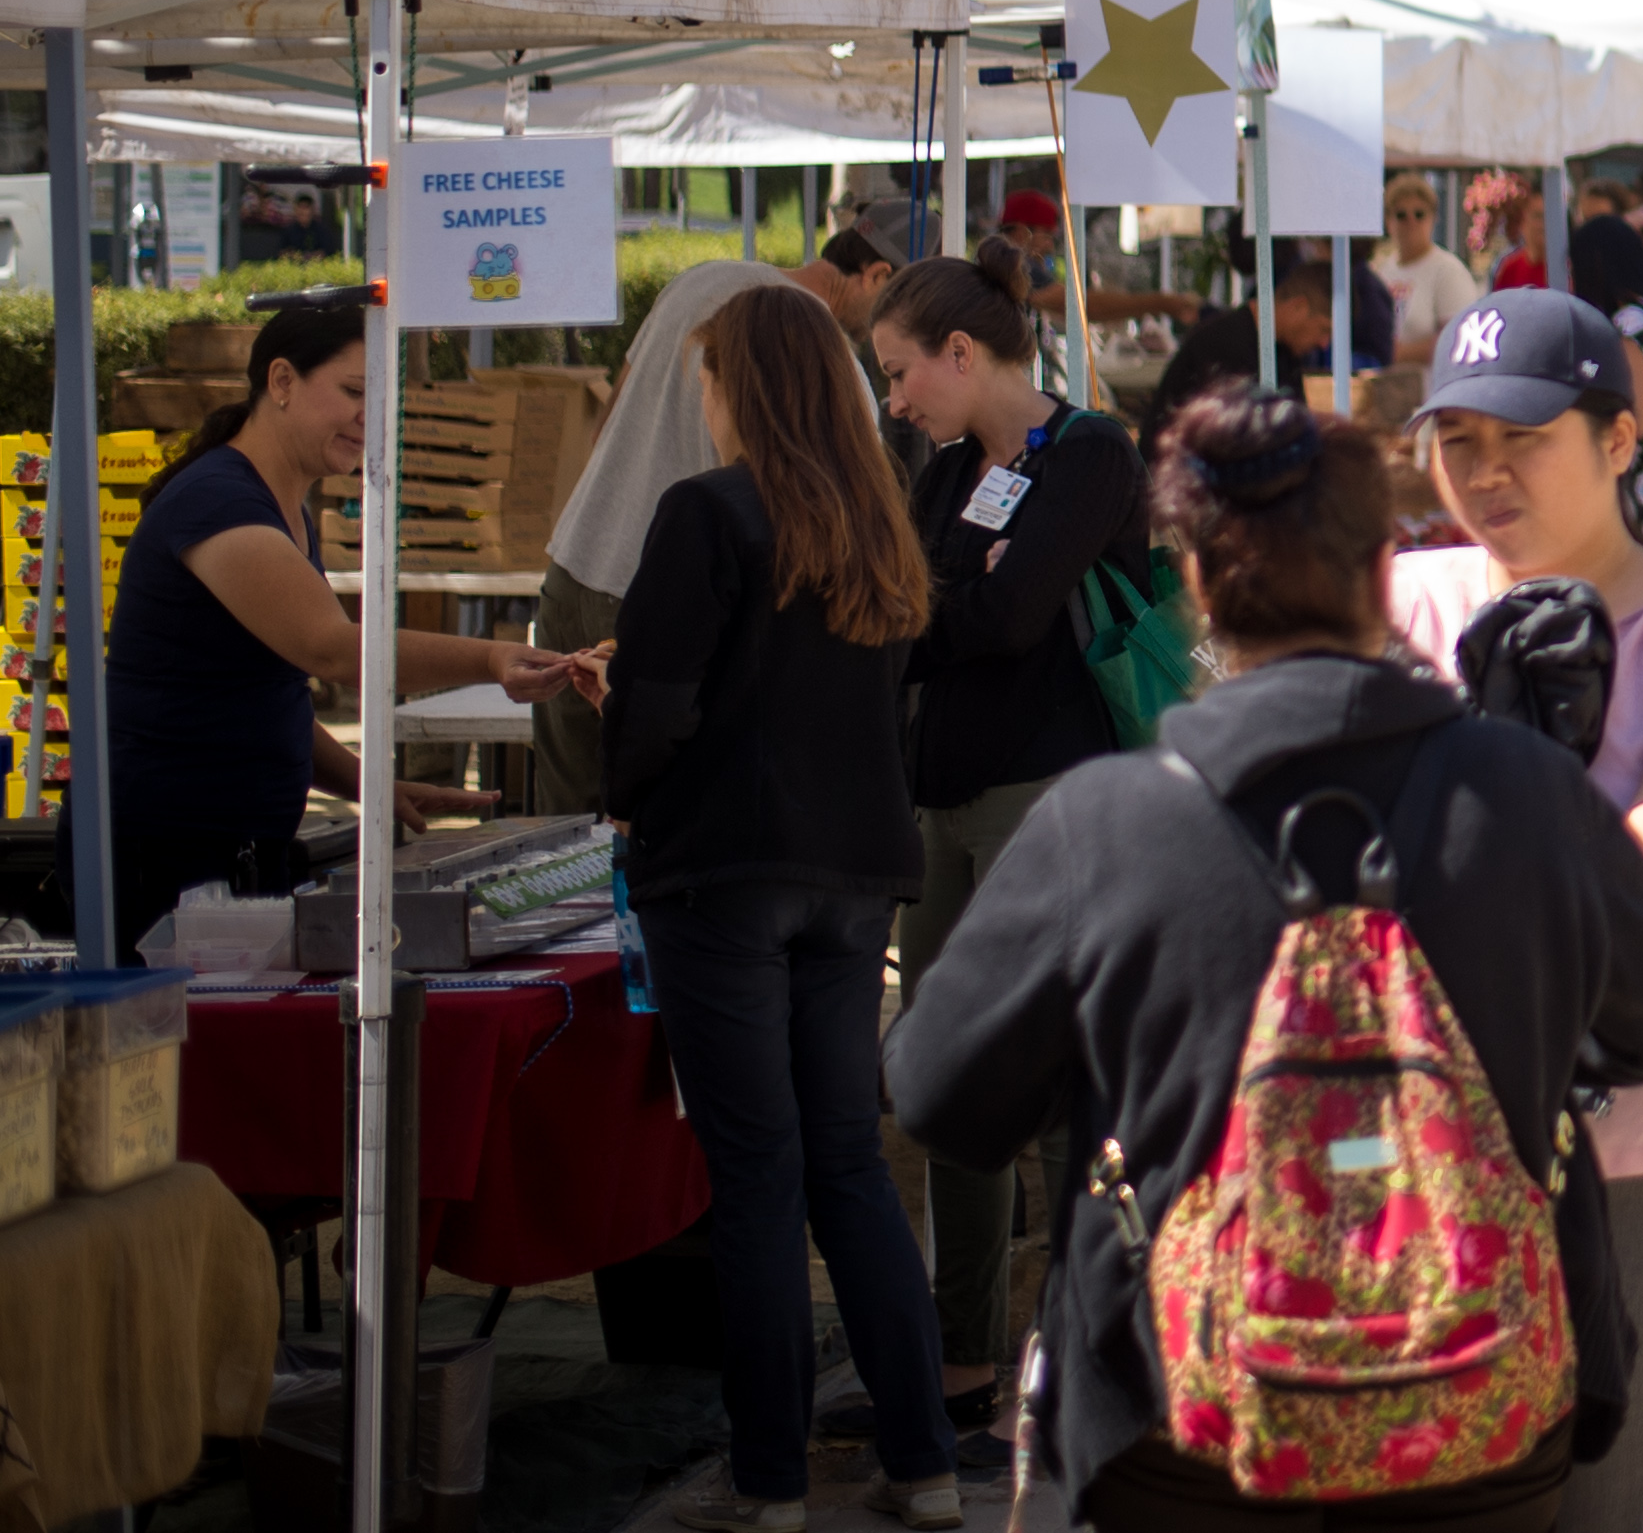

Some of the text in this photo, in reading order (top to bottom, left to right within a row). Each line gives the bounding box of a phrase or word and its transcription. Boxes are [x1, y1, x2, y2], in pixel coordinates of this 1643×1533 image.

[423, 169, 565, 193] FREE CHEESE
[443, 206, 547, 229] SAMPLES
[1451, 309, 1505, 364] NY
